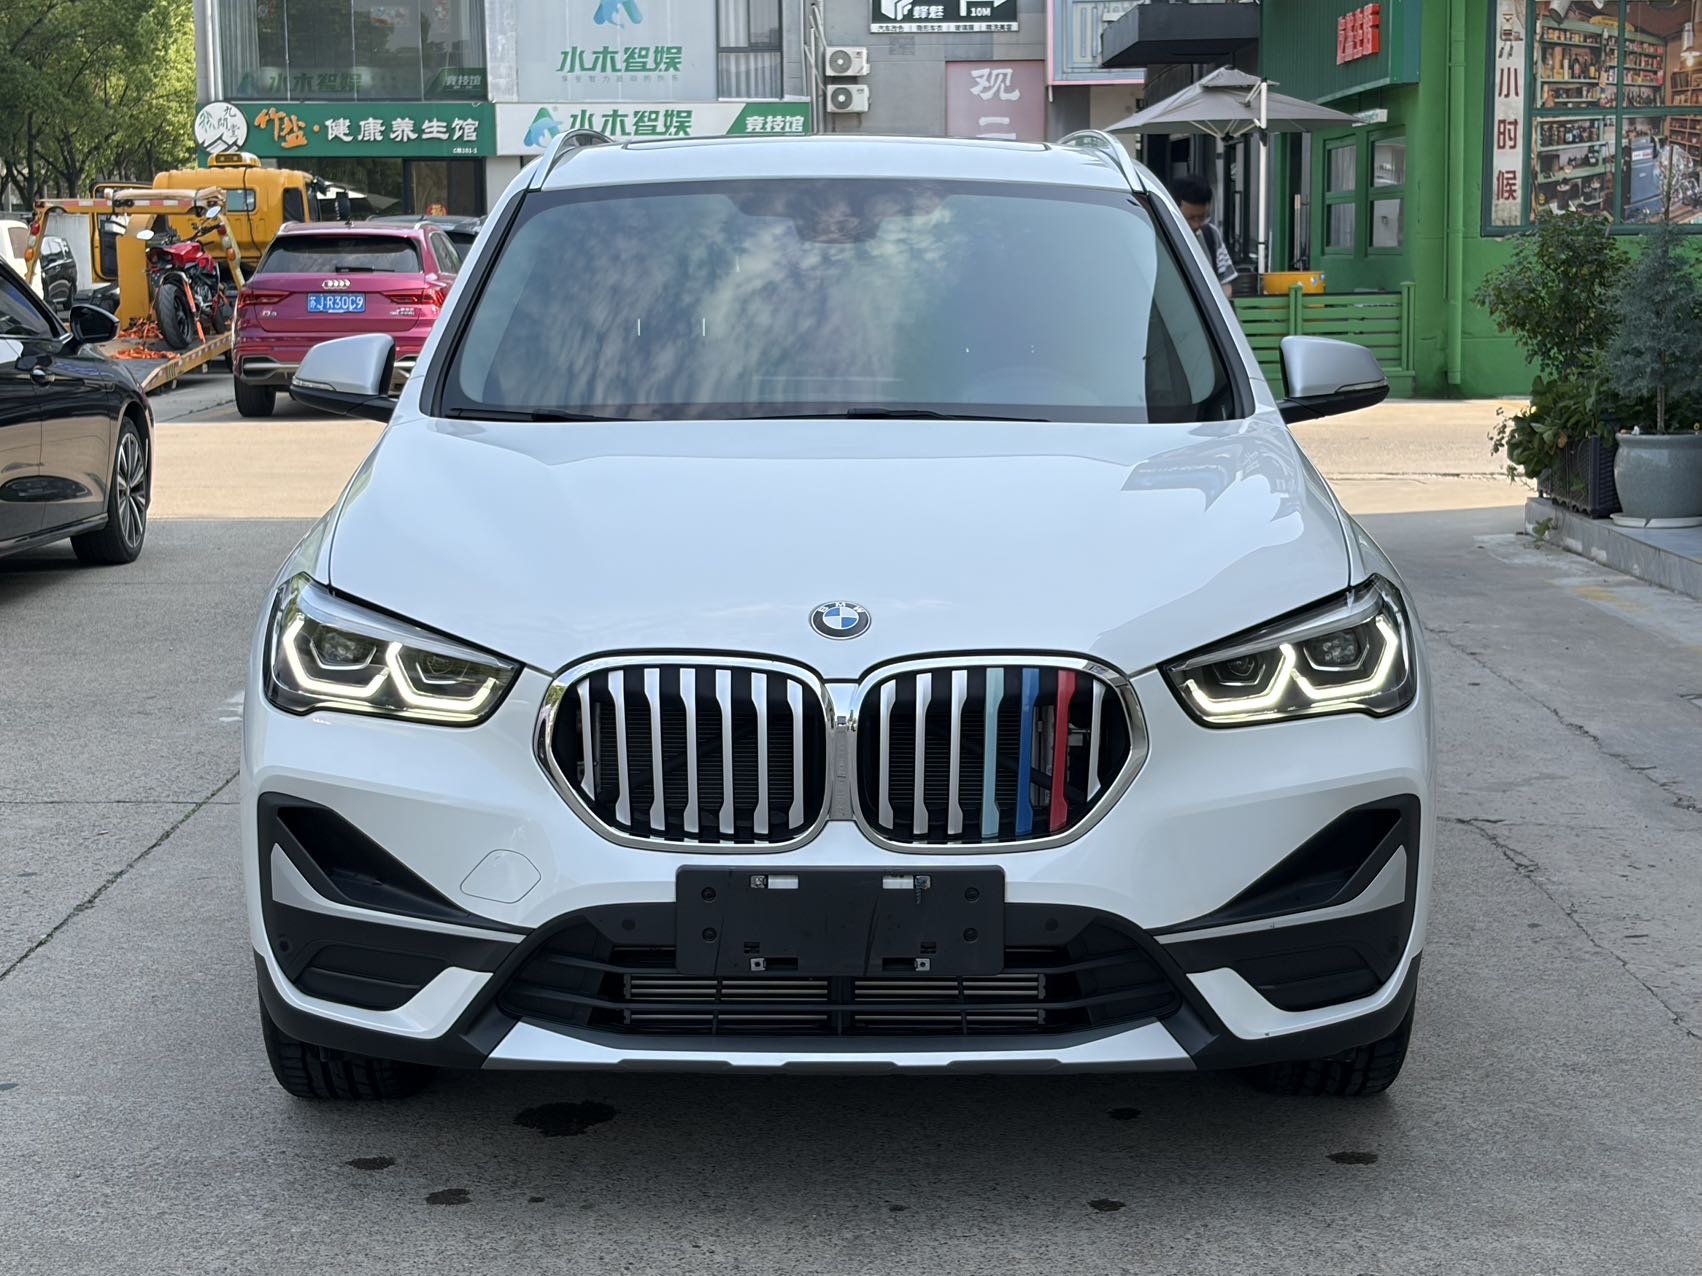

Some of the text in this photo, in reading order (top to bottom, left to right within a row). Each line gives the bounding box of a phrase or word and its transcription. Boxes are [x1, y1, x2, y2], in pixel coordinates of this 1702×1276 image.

[556, 46, 683, 73] 水木智娱
[570, 109, 805, 136] 水木智娱 竞技馆
[1496, 67, 1519, 201] 小时候
[817, 602, 865, 613] BMW
